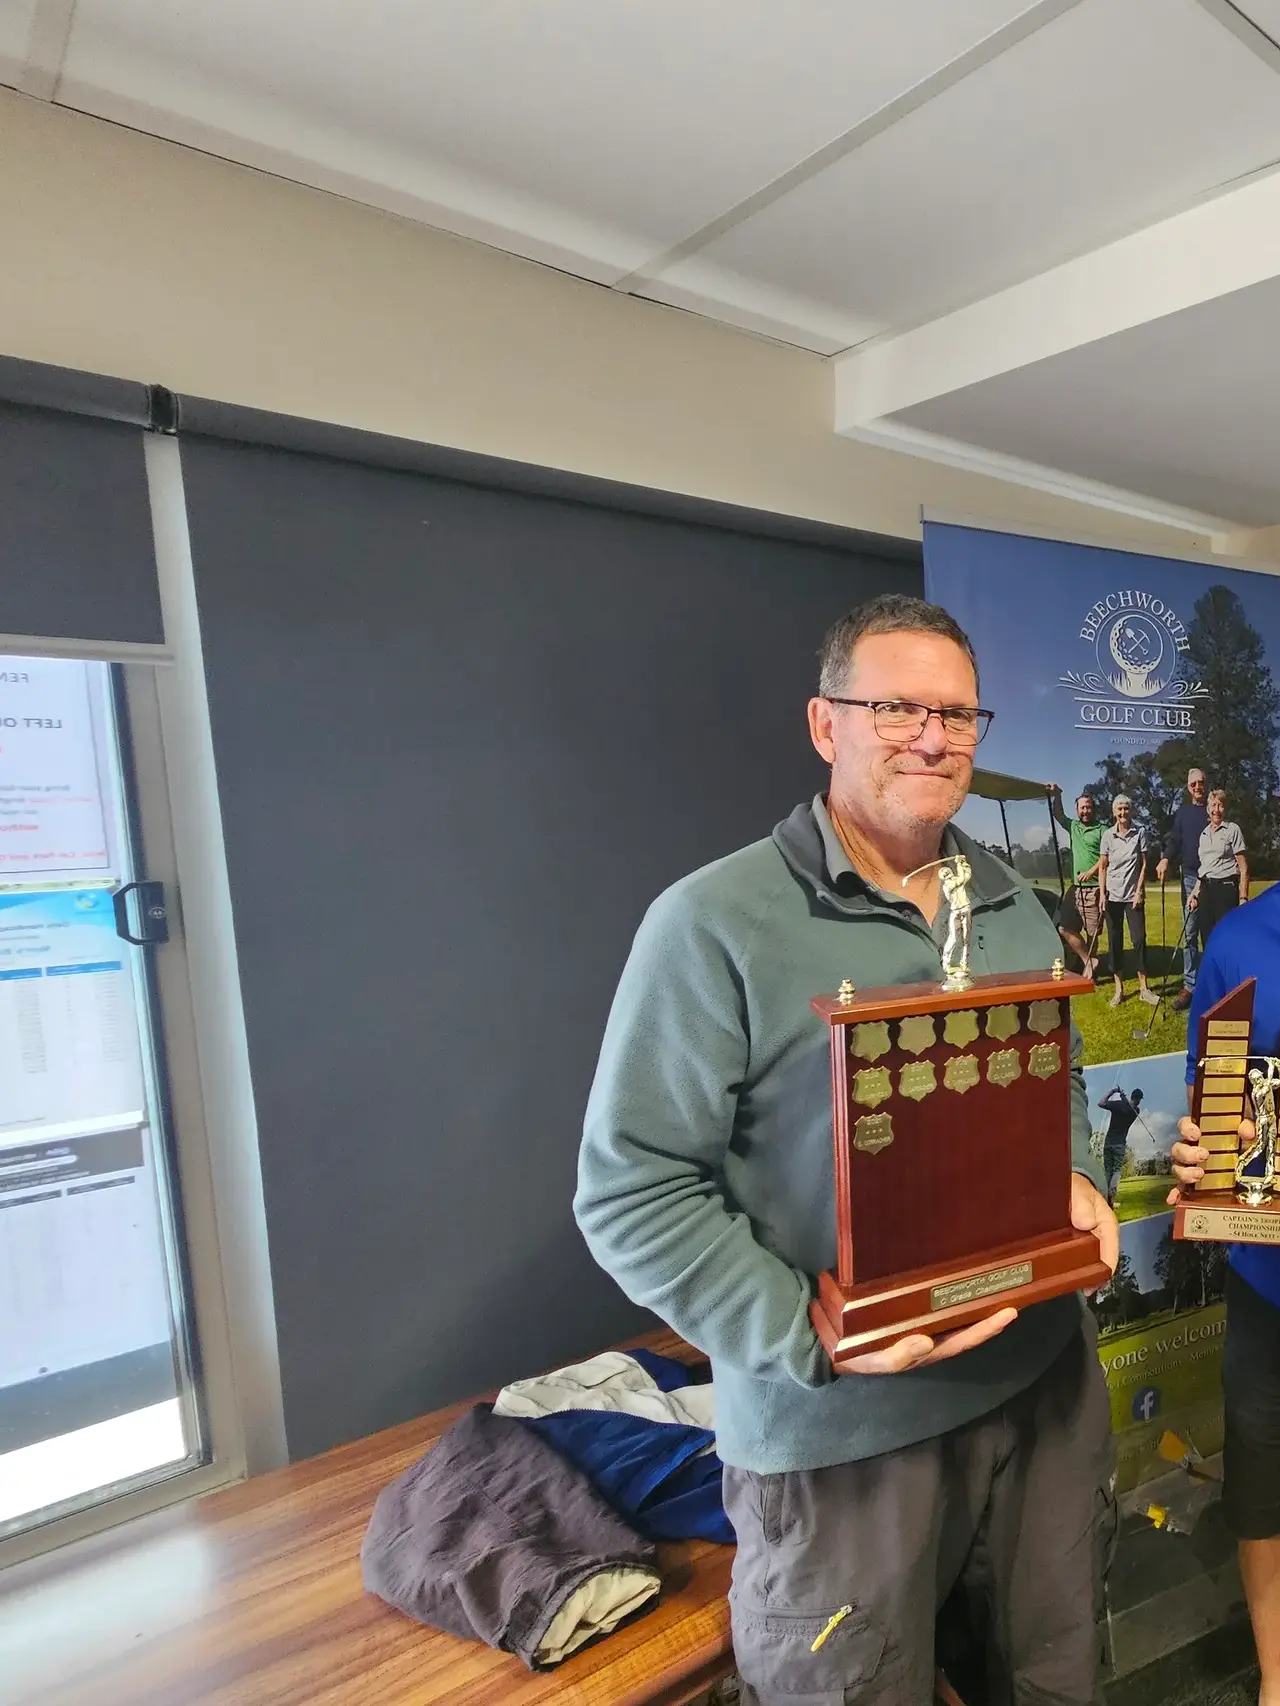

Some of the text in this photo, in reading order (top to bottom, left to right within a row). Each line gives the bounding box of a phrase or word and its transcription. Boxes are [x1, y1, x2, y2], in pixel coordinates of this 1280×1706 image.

[1079, 590, 1191, 652] BEECHWORTH
[1080, 704, 1192, 727] GOLF CLUB
[934, 1264, 1029, 1297] BEECHWORTH GOLF CLUB
[950, 1291, 972, 1303] Grade
[976, 1276, 1024, 1295] Championship
